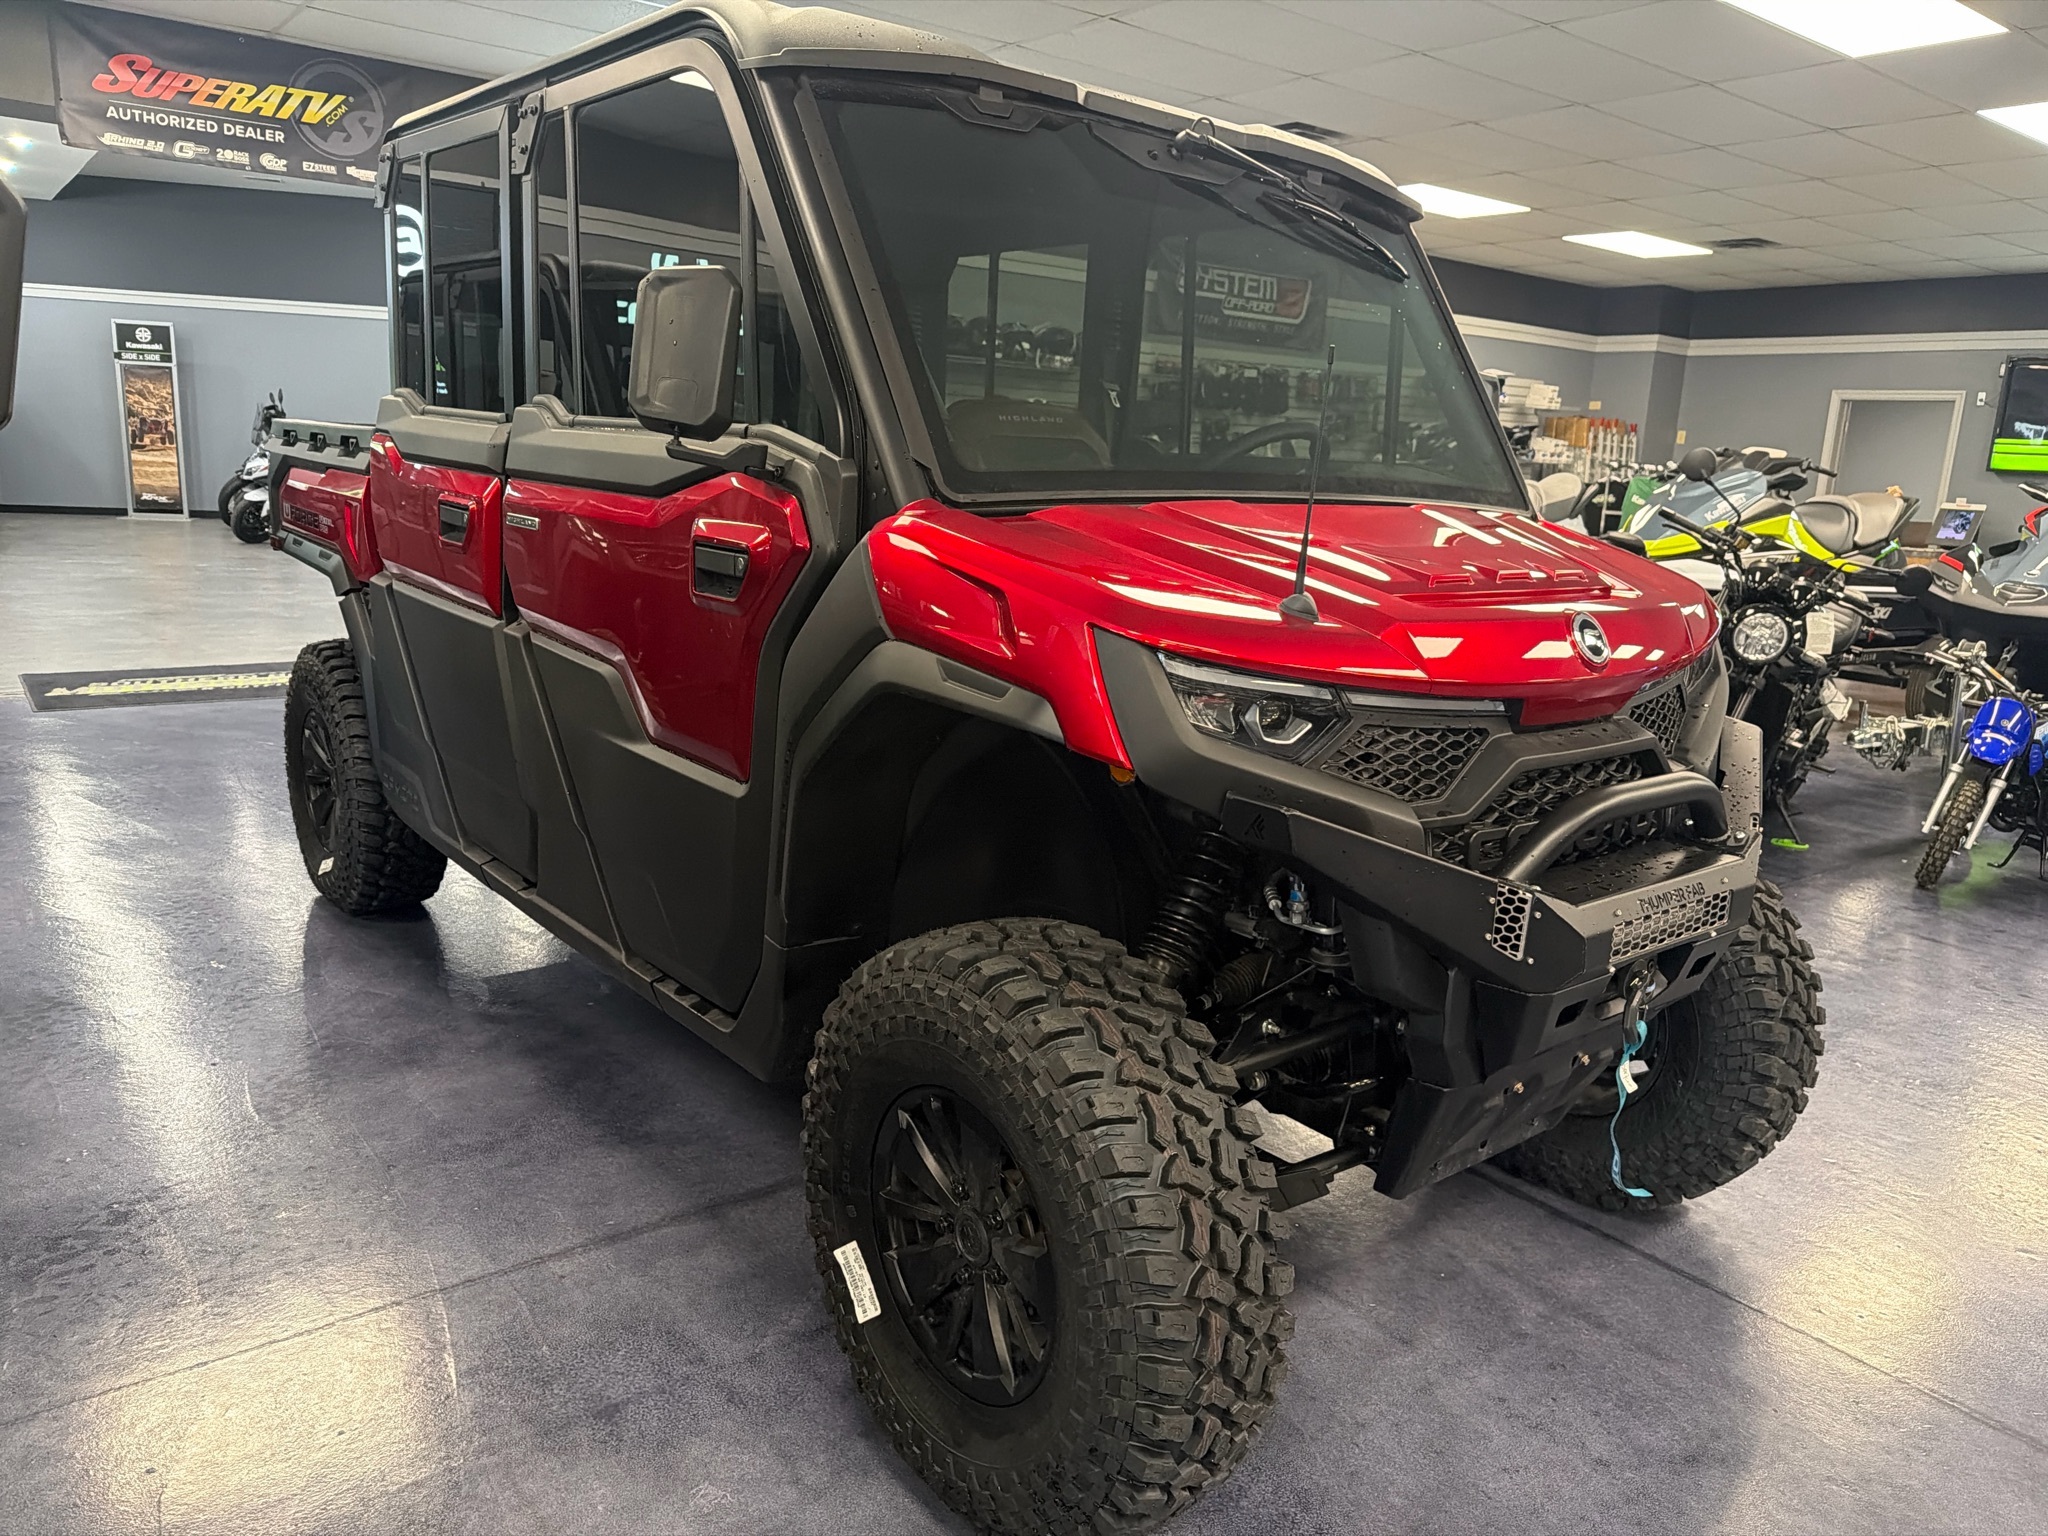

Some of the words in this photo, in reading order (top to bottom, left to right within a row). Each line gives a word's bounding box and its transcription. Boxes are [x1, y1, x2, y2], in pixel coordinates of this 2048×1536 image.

[106, 105, 218, 133] AUTHORIZED
[223, 122, 285, 144] DEALER
[121, 352, 138, 360] SIDE
[1685, 882, 1706, 900] FAB
